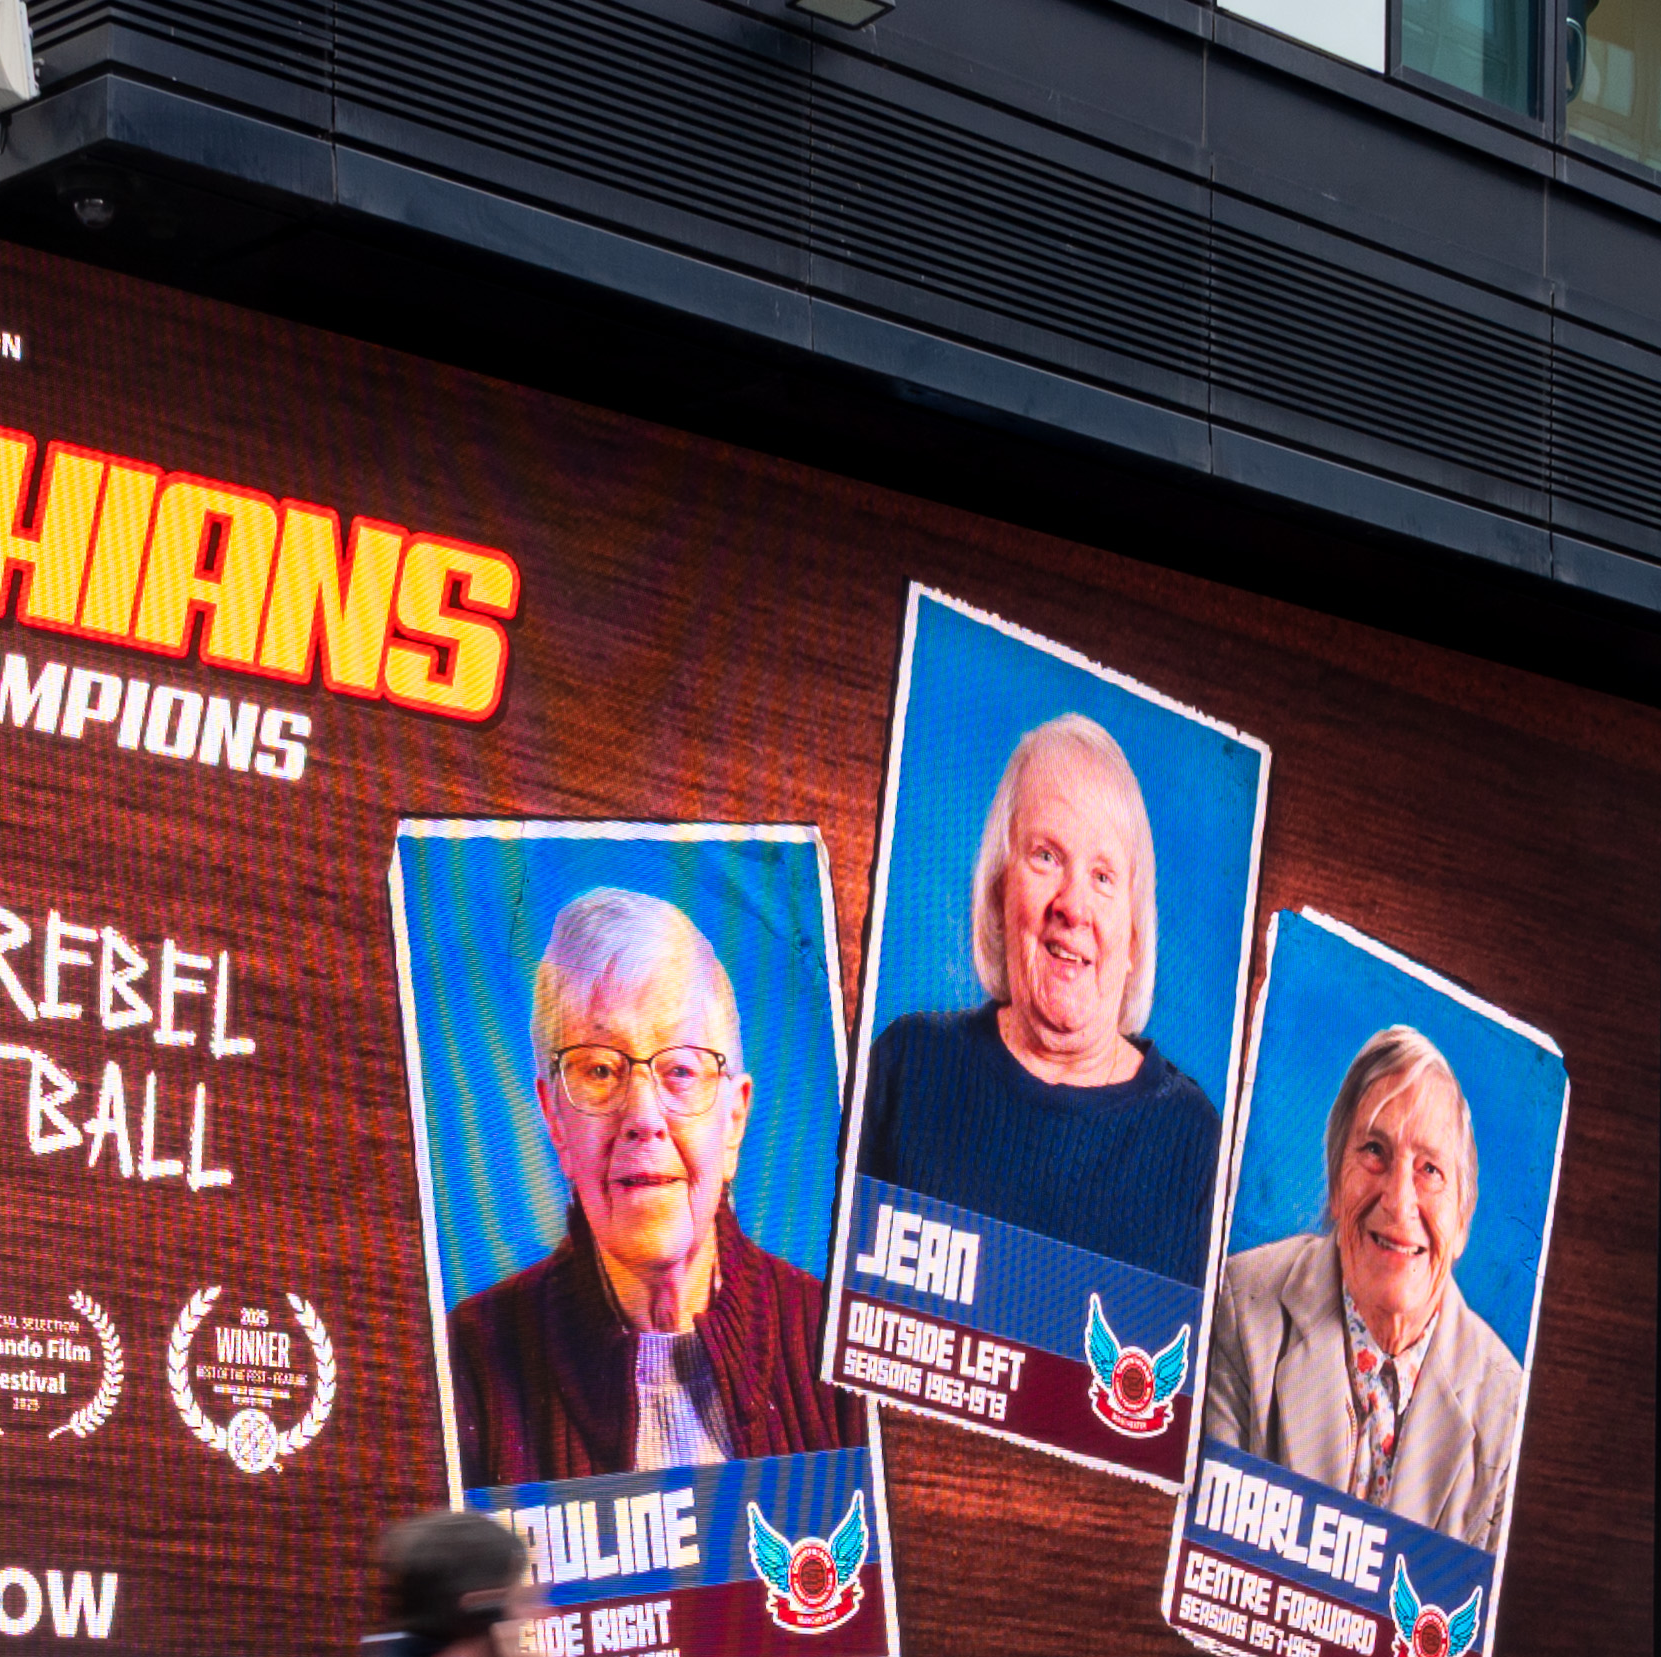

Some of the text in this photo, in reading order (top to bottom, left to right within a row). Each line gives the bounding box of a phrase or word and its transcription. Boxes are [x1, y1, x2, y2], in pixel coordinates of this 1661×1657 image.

[856, 1204, 980, 1305] JEAN
[47, 1337, 91, 1361] Film
[215, 1327, 290, 1369] WINNER
[843, 1347, 1007, 1421] SEASONS 1963-1973
[847, 1301, 1026, 1391] OUTSIDE LEFT
[490, 1488, 700, 1587] AULINE
[1195, 1458, 1387, 1592] MARLENE
[591, 1600, 671, 1653] RIGHT
[1179, 1594, 1247, 1640] SEASONS
[1184, 1551, 1273, 1615] CENTRE
[1275, 1585, 1378, 1657] FORWARD
